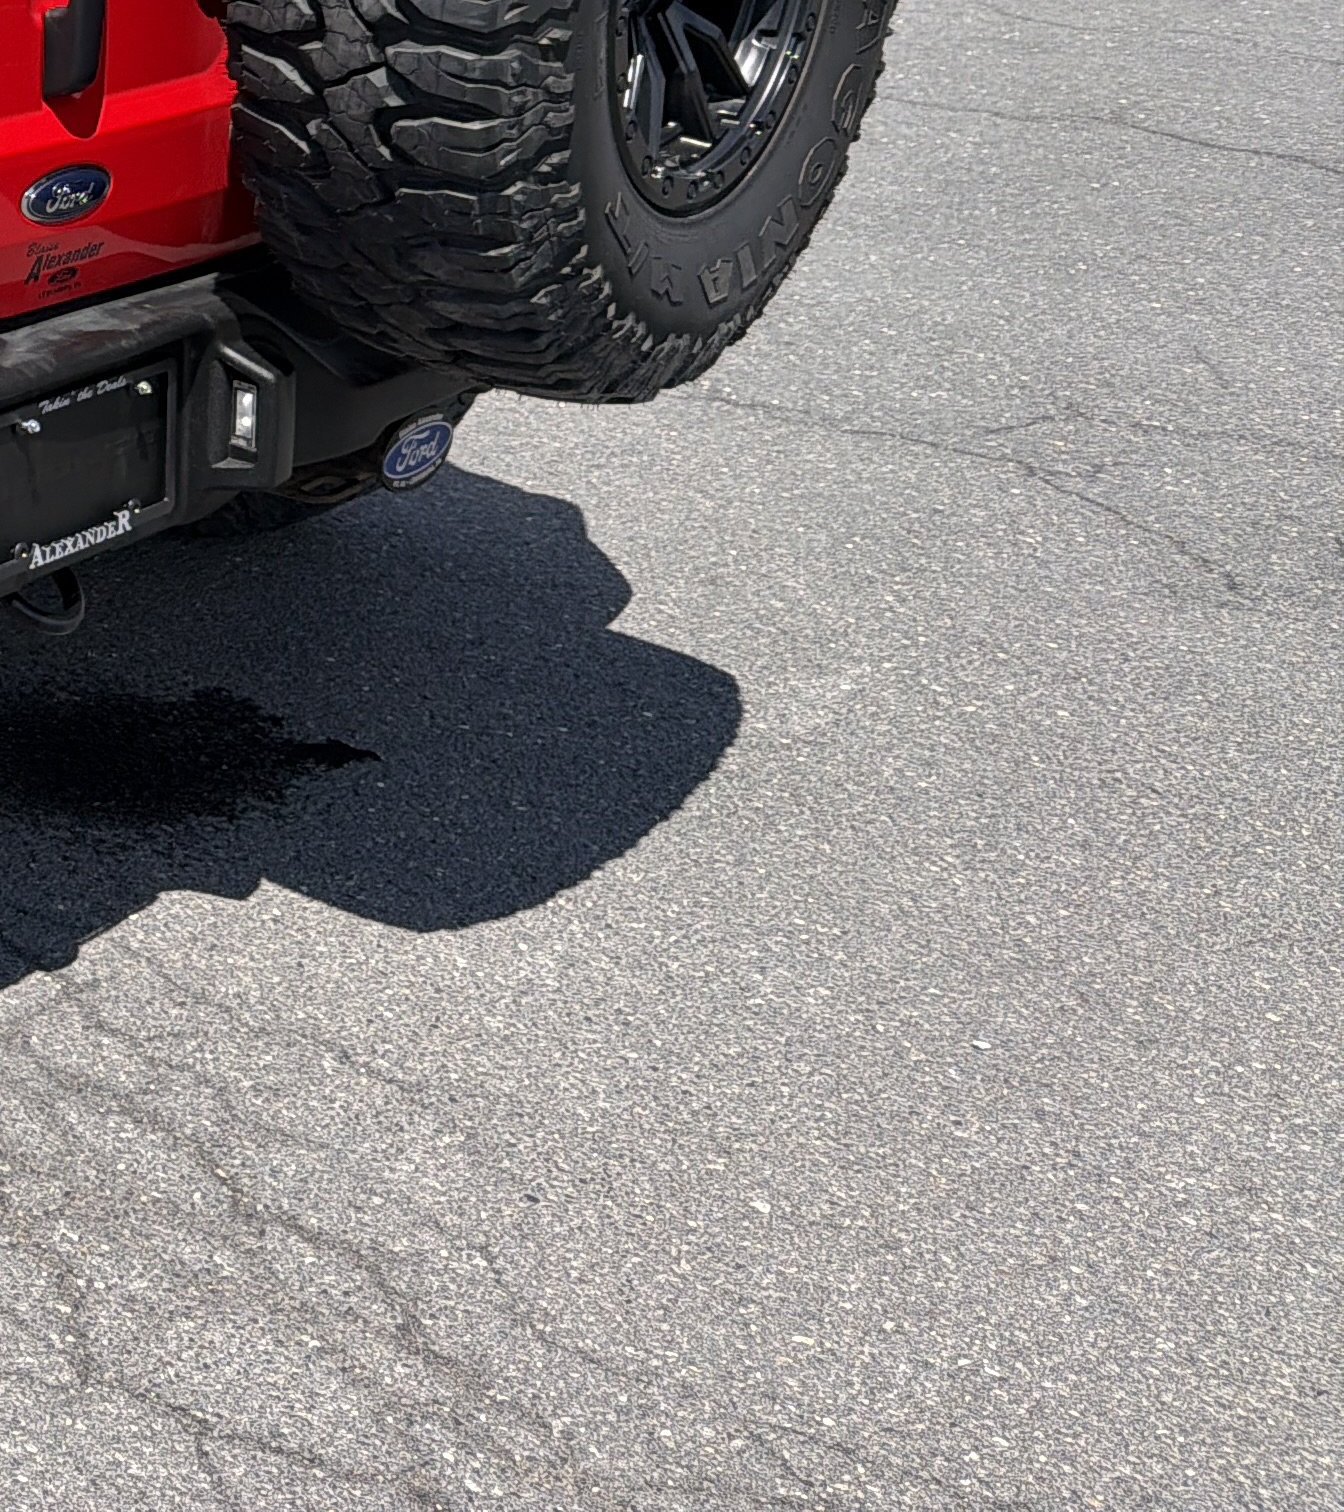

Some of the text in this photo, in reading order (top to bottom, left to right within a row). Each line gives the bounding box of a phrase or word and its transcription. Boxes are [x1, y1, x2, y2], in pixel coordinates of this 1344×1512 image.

[46, 180, 95, 213] Ford
[24, 242, 105, 285] Alexander
[395, 429, 441, 473] Ford
[29, 509, 132, 569] ALEXANDER
